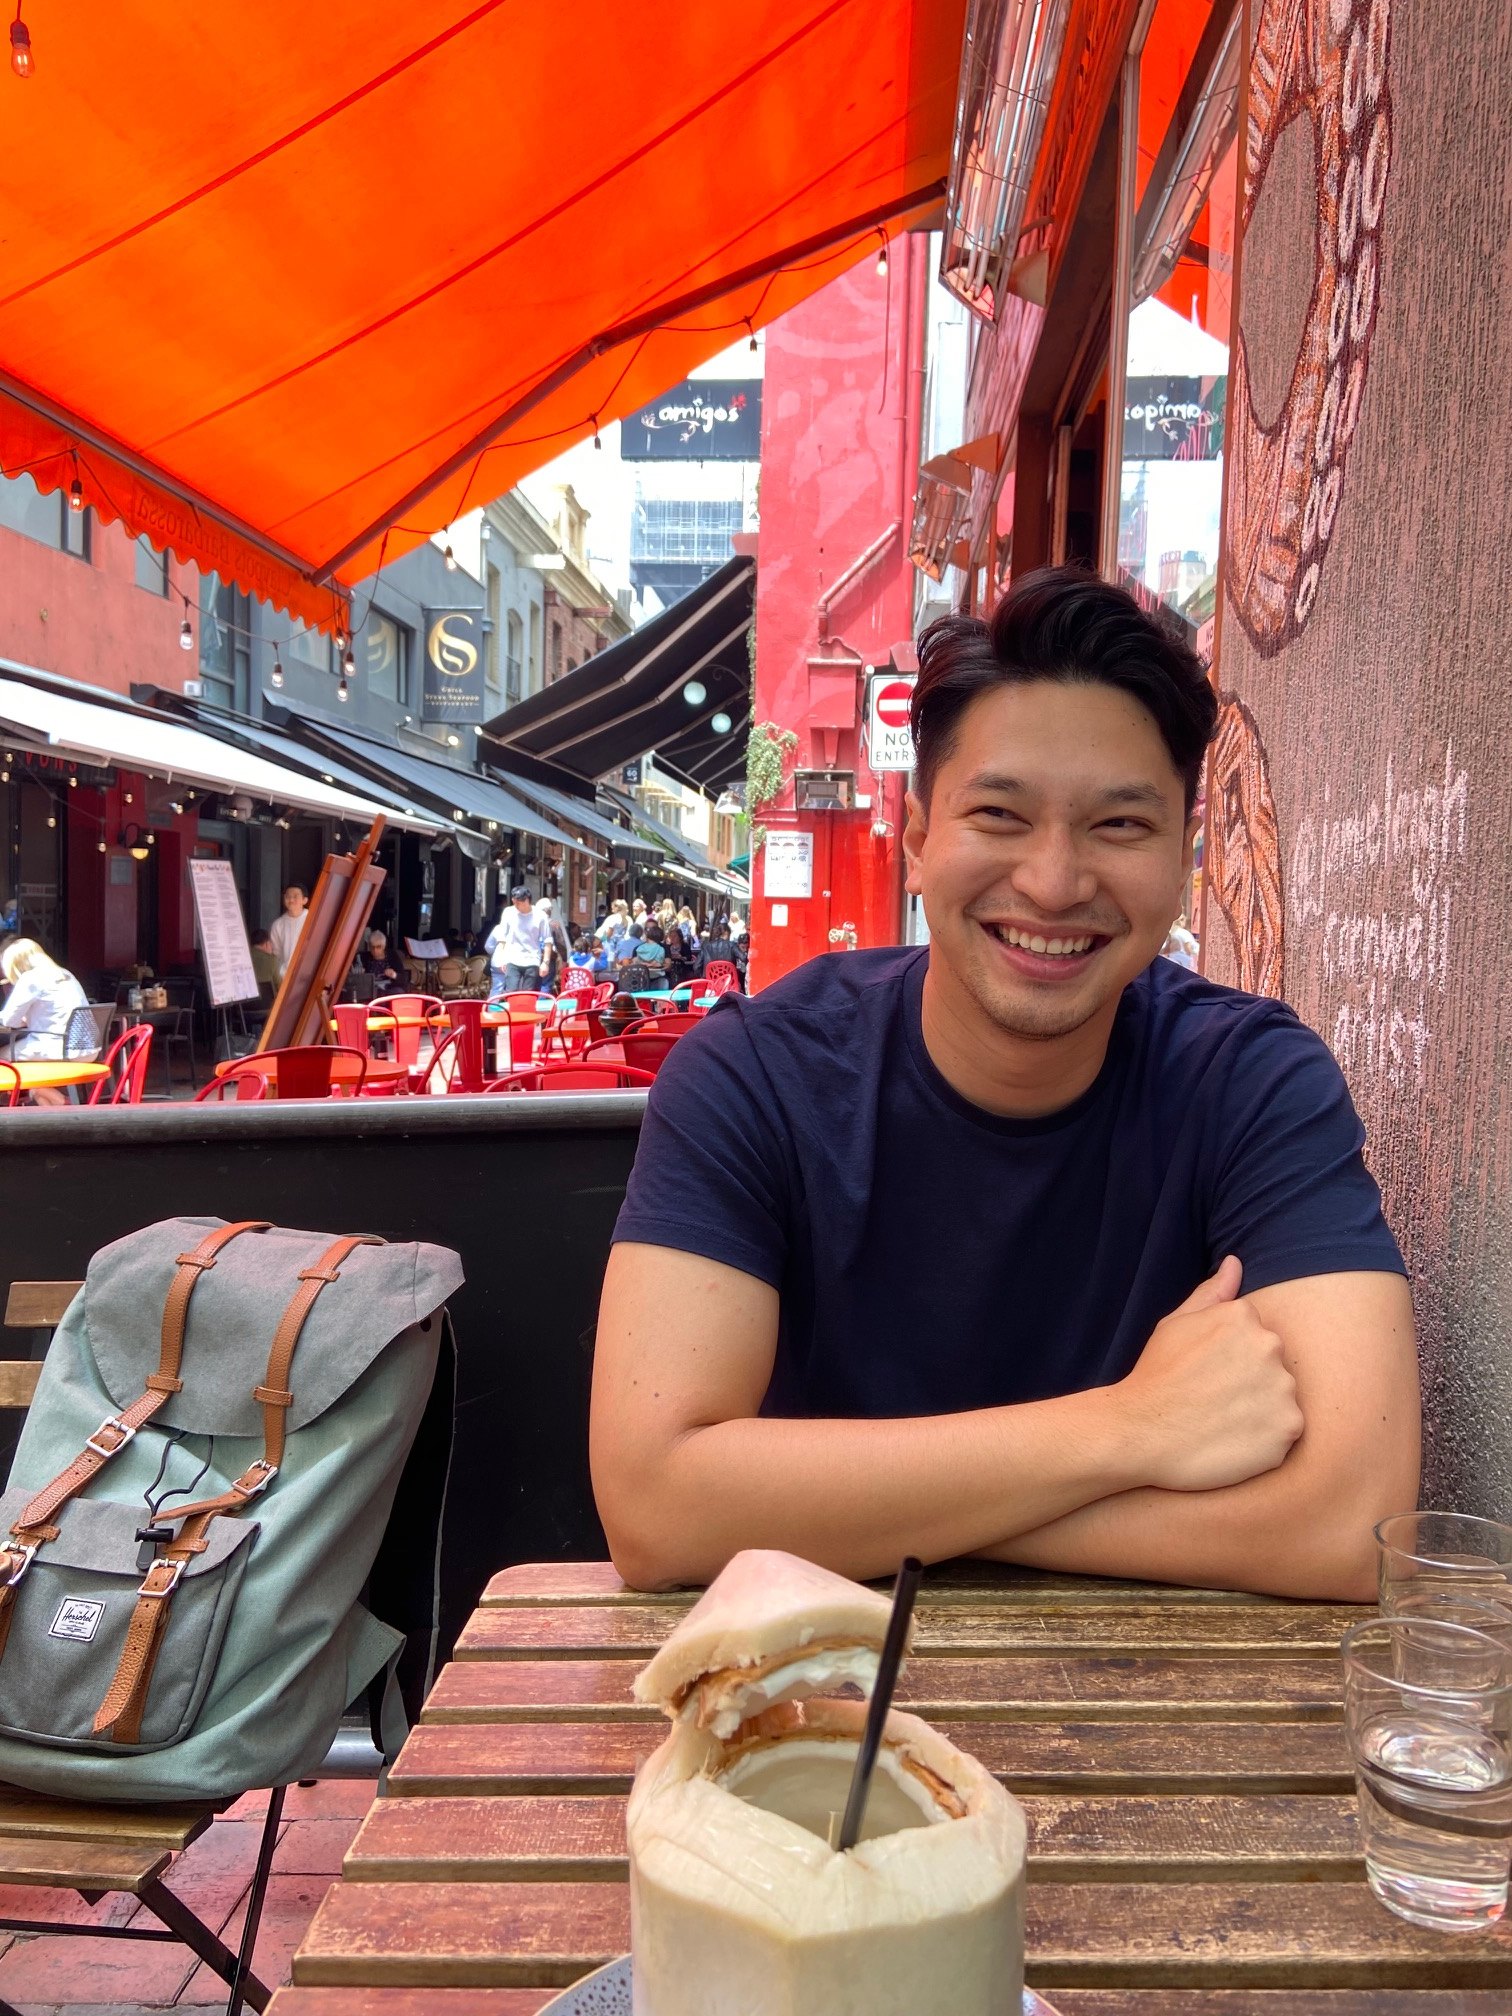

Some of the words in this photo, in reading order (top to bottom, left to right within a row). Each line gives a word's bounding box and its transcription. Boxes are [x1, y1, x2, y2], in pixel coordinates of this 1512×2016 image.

[658, 397, 739, 433] amigos
[886, 733, 909, 746] NO
[62, 1607, 96, 1622] Herschel
